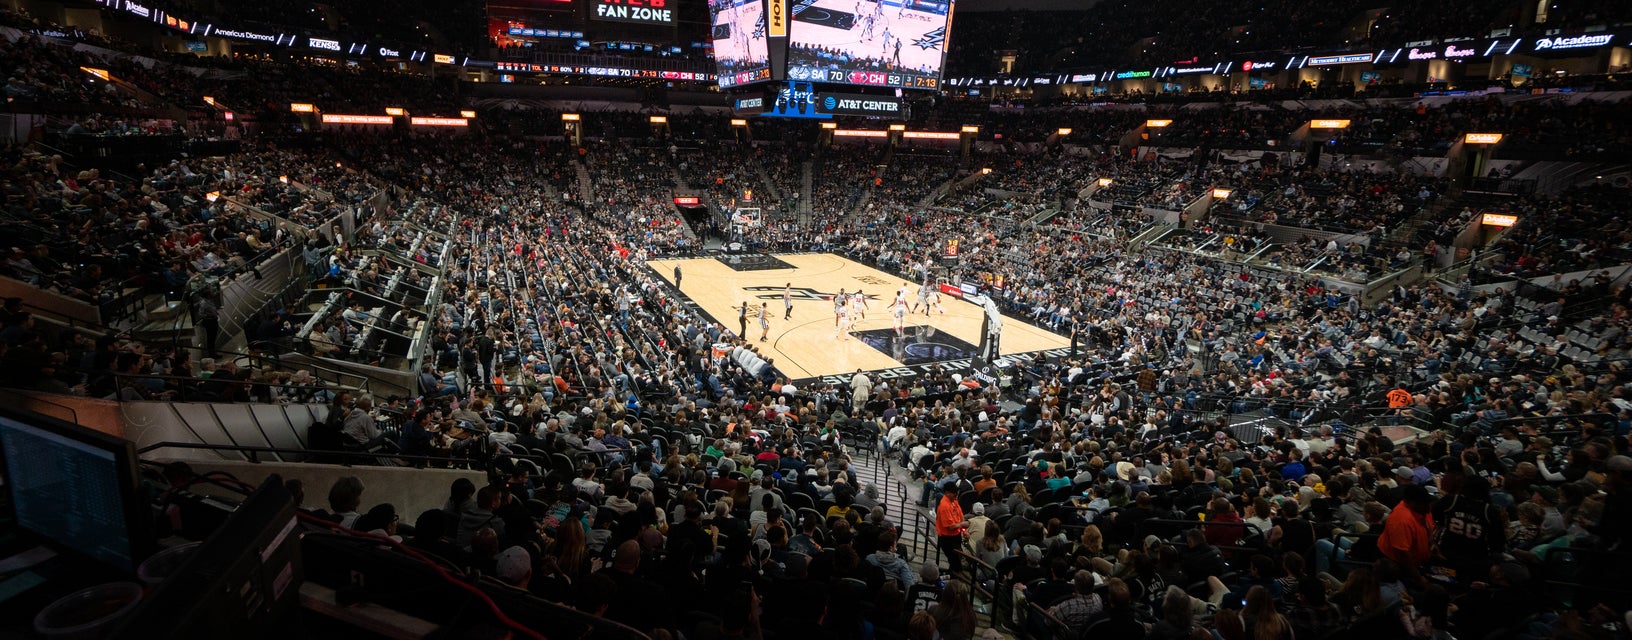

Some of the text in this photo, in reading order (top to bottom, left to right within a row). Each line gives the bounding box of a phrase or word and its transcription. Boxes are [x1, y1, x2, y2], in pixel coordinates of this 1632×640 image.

[597, 4, 671, 22] FAN ZONE
[215, 28, 275, 42] Americus Diamond
[1553, 35, 1614, 46] Academy
[608, 68, 619, 76] SA
[620, 69, 631, 77] 70
[680, 72, 693, 80] CHI
[811, 70, 825, 80] SA
[830, 71, 843, 81] 70
[869, 74, 884, 84] CHI
[888, 75, 900, 85] 52
[916, 77, 936, 87] 7:13
[838, 99, 898, 111] AT&T CENTER
[1392, 393, 1407, 403] 173
[1449, 517, 1482, 539] 20
